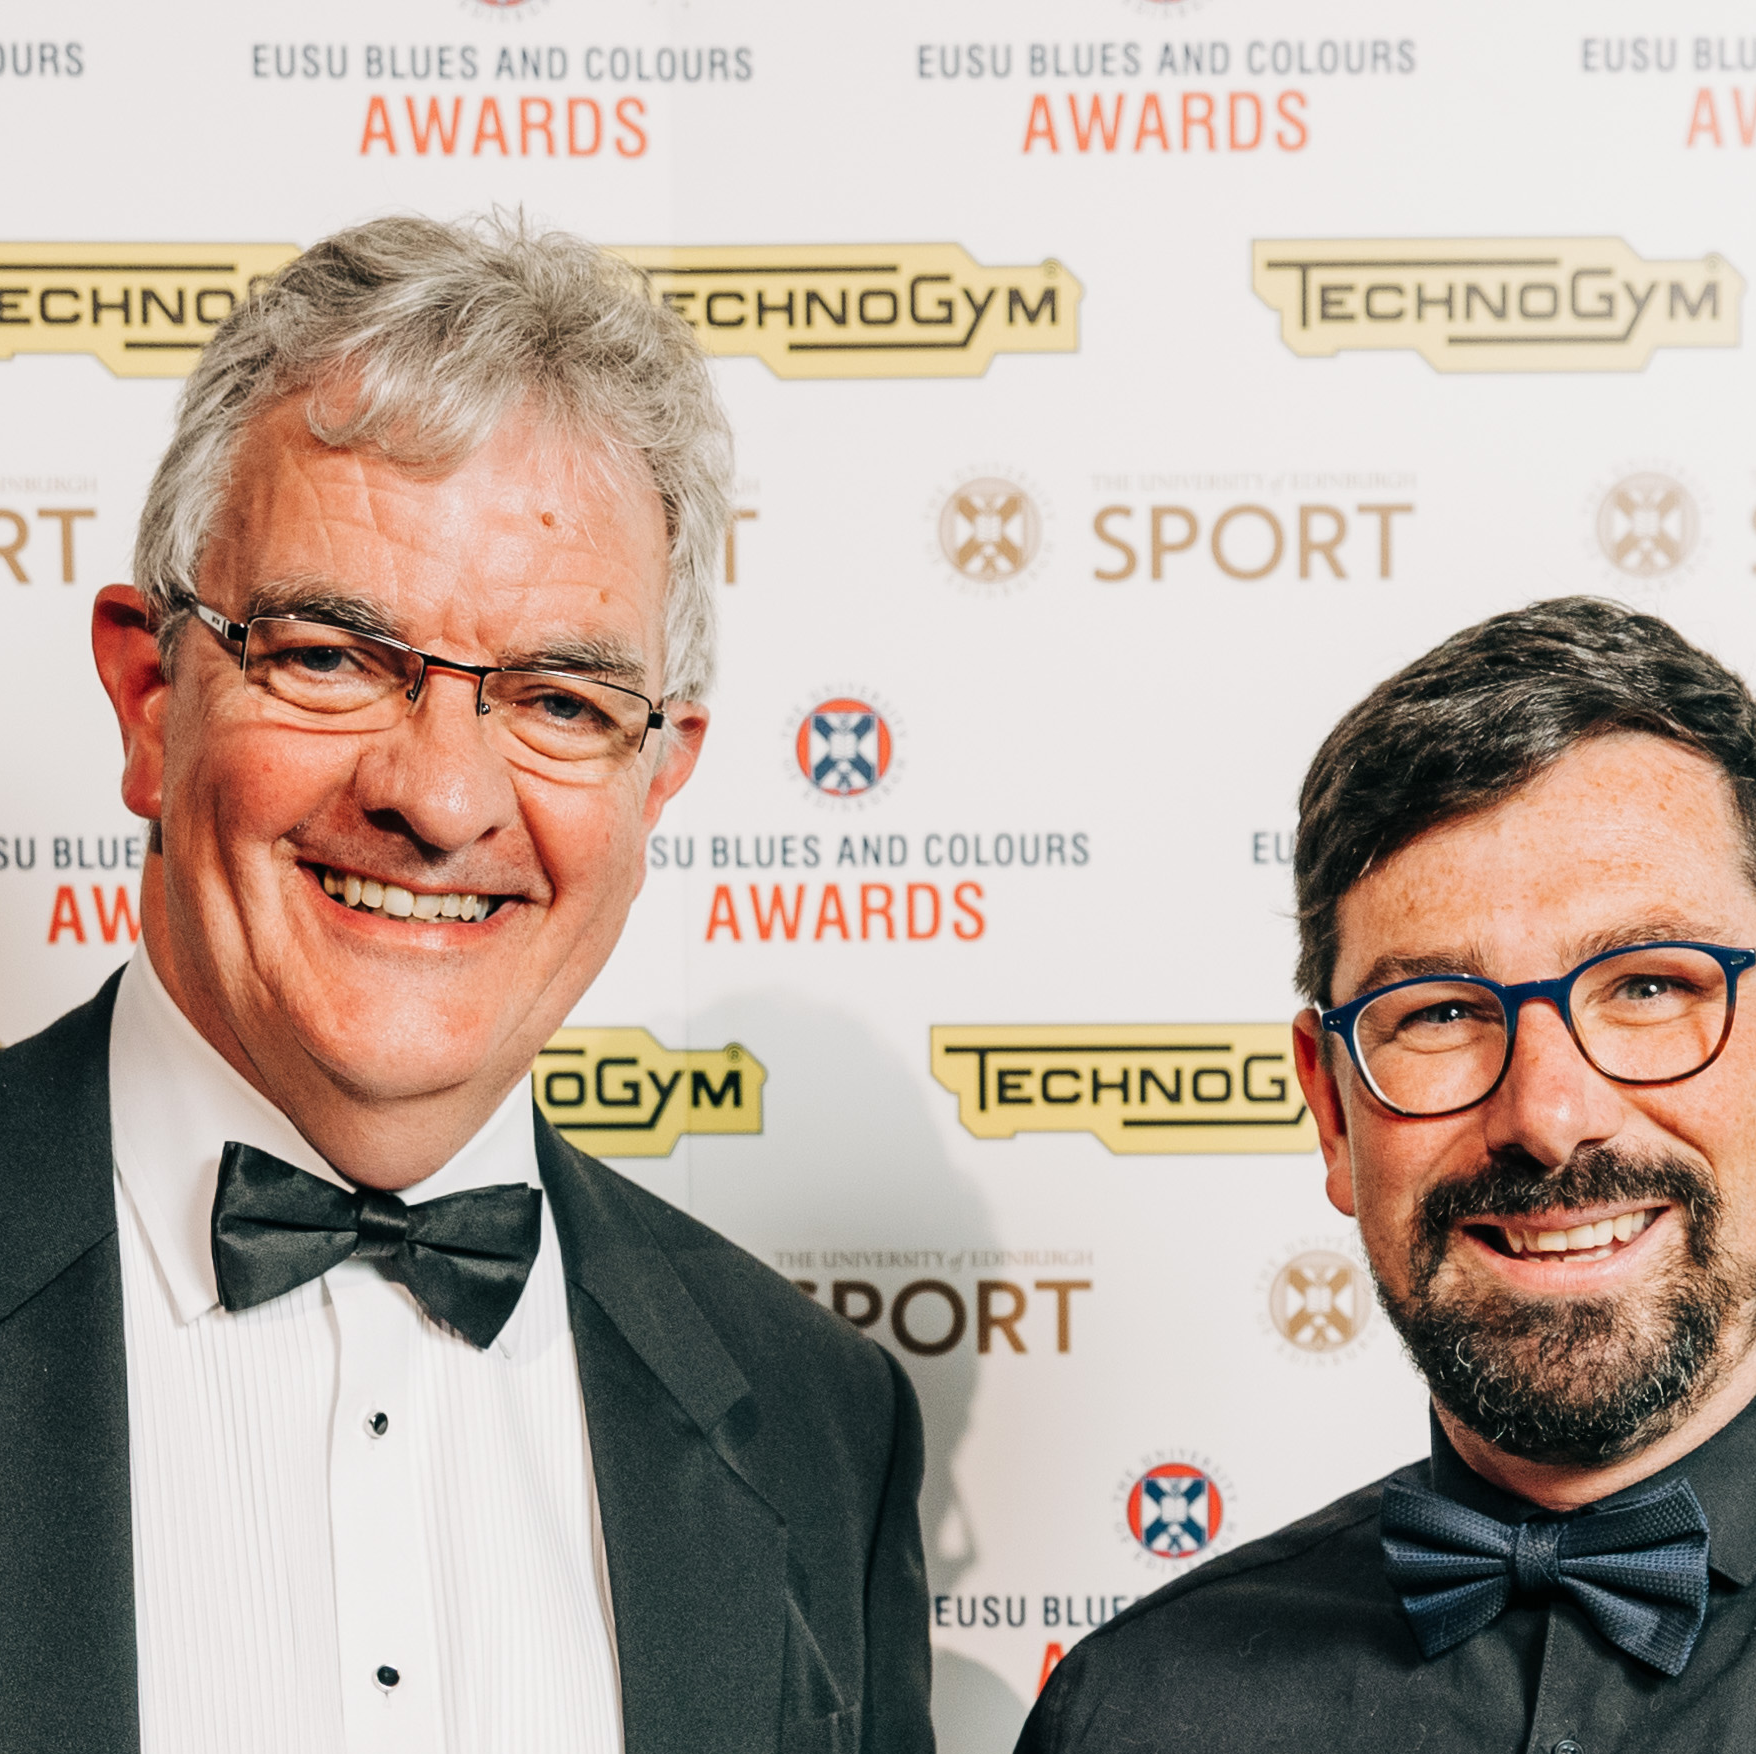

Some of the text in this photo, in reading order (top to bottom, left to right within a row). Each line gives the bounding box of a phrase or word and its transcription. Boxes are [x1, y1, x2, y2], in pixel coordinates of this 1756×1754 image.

[251, 42, 754, 84] EUSU BLUES AND COLOURS
[916, 38, 1416, 81] EUSU BLUES AND COLOURS
[359, 95, 648, 159] AWARDS
[1022, 90, 1308, 154] AWARDS
[1092, 503, 1414, 584] SPORT
[710, 832, 1090, 870] BLUES AND COLOURS
[705, 881, 986, 942] AWARDS
[823, 1250, 947, 1269] UNIVERSITY
[795, 1279, 1092, 1357] PORT
